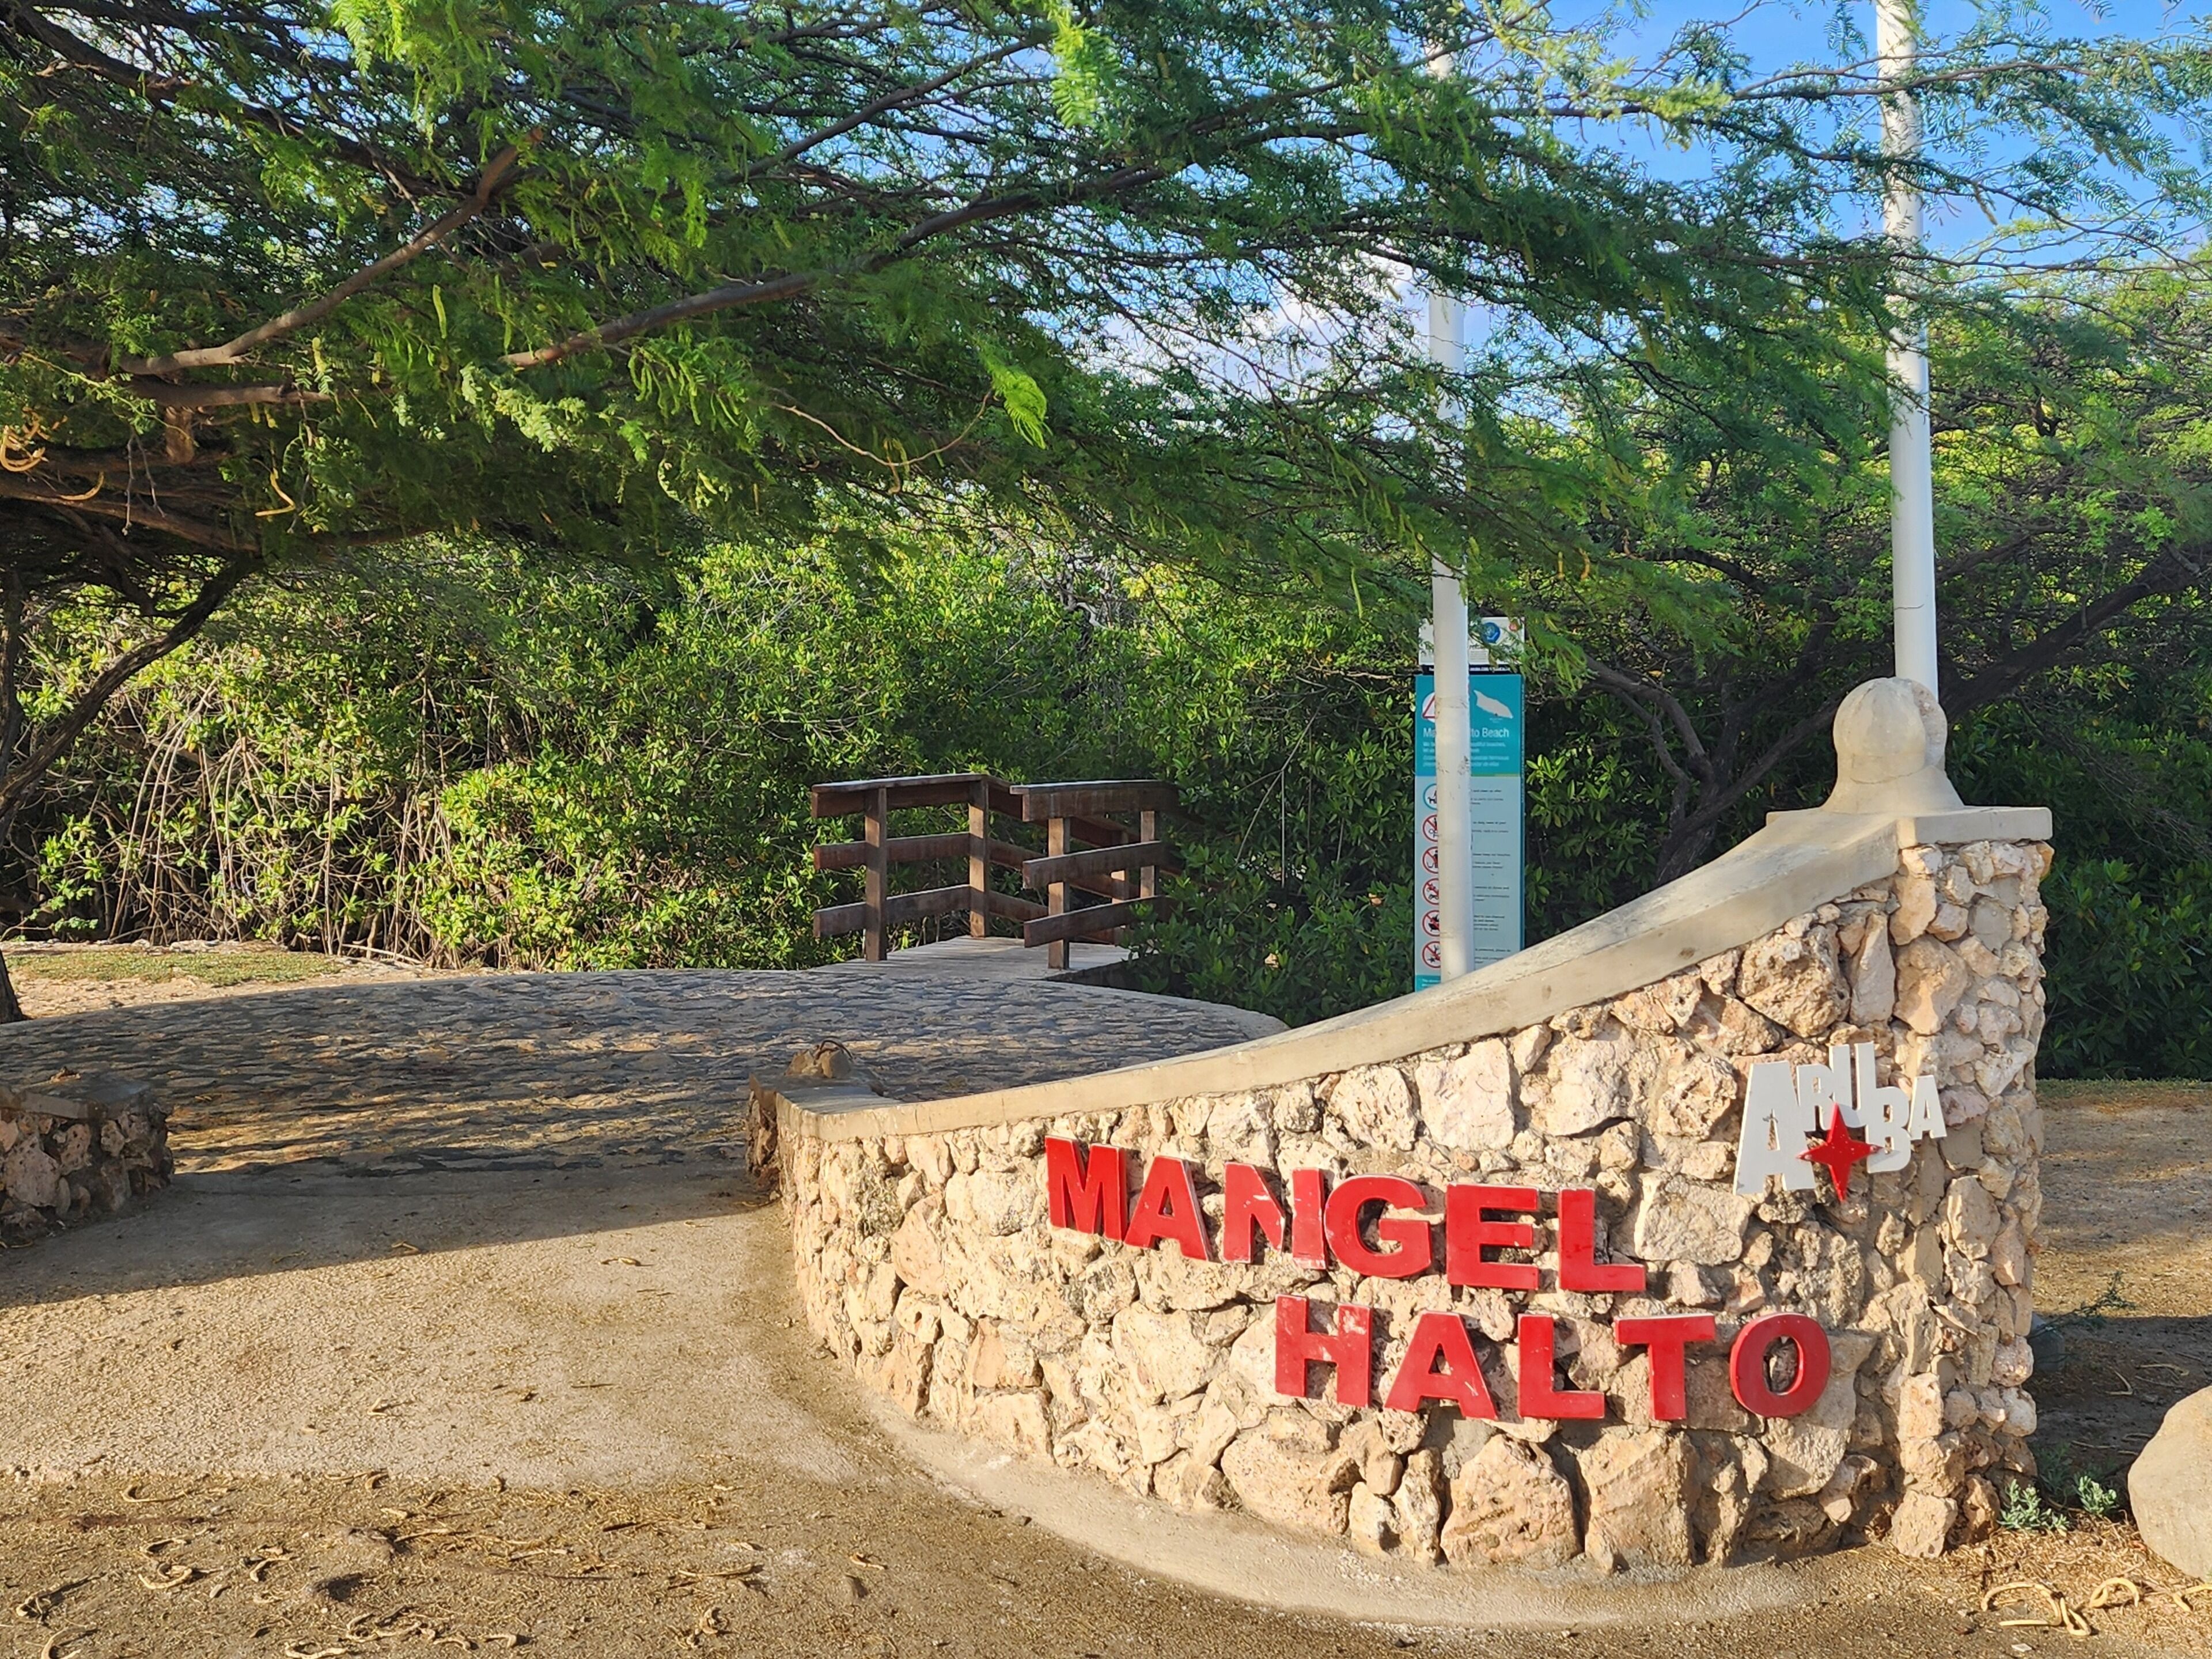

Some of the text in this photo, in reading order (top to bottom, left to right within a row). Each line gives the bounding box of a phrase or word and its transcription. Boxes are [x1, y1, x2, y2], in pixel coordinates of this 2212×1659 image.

[1482, 728, 1509, 738] Beach
[1733, 1041, 1947, 1196] ARUBA
[1045, 1135, 1646, 1292] MANGEL
[1275, 1294, 1831, 1421] HALTO
